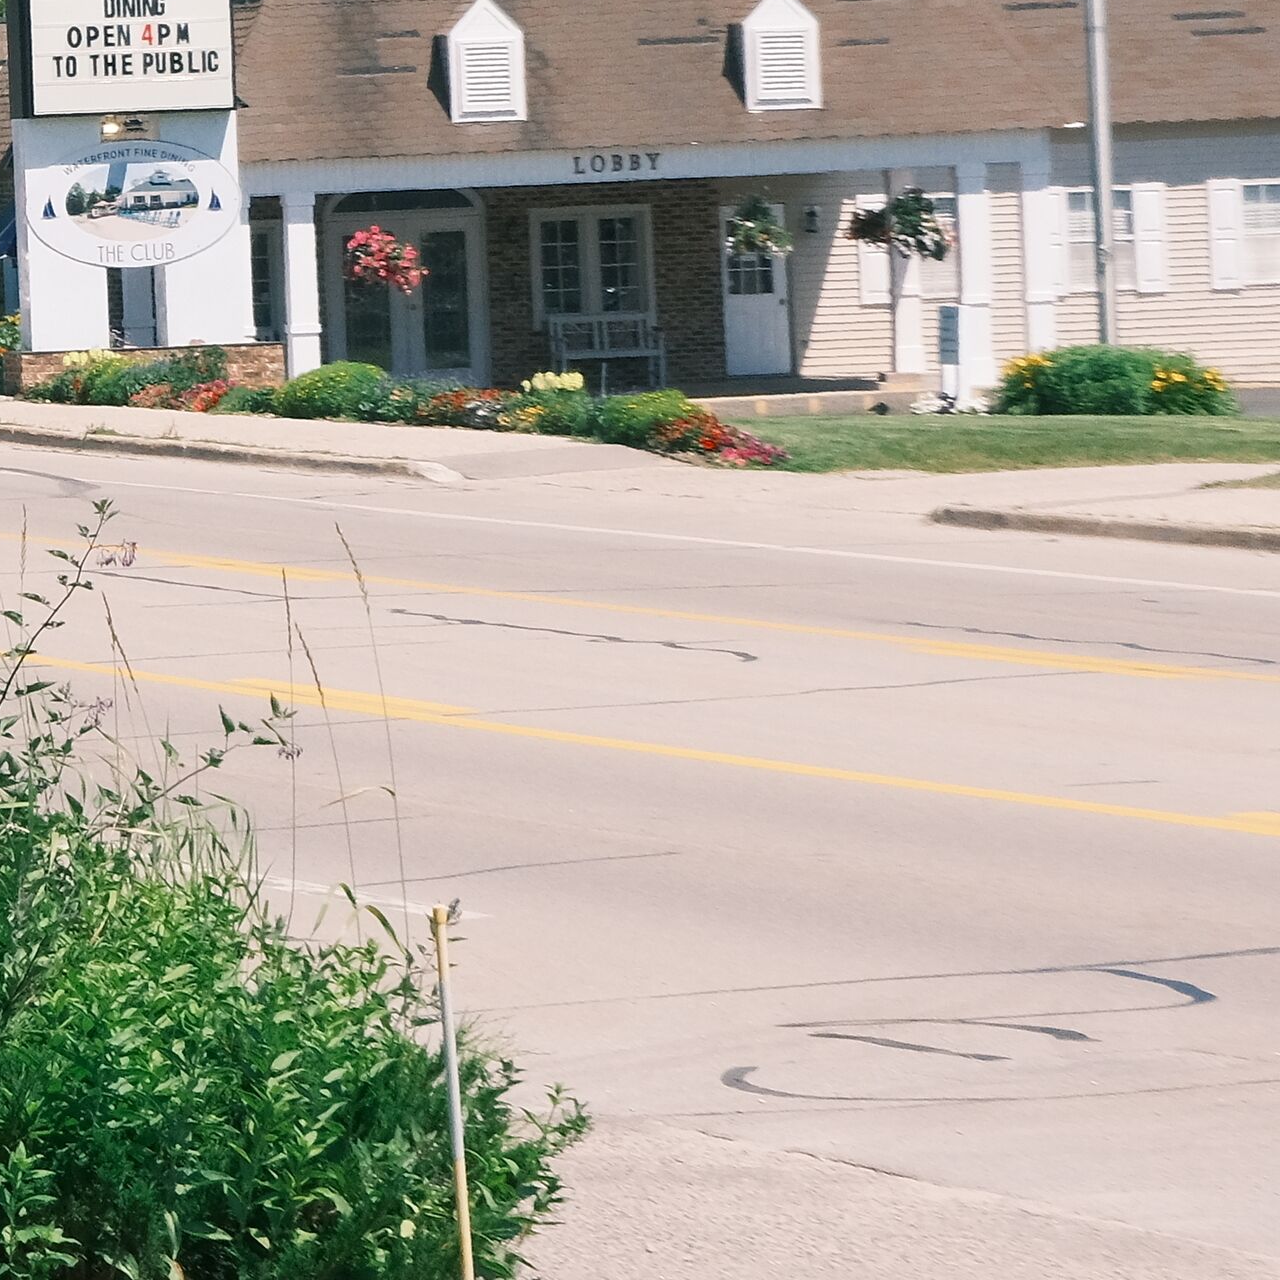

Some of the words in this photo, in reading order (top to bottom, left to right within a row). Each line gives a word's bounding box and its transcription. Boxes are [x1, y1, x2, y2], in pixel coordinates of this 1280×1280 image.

[67, 24, 131, 48] OPEN
[52, 55, 78, 78] TO
[90, 53, 133, 77] THE
[143, 50, 219, 75] PUBLIC
[63, 148, 131, 176] WATERFRONT
[134, 148, 158, 159] FINE
[160, 150, 196, 173] DINING
[572, 153, 660, 174] LOBBY
[97, 244, 125, 263] THE
[130, 243, 175, 261] CLUB
